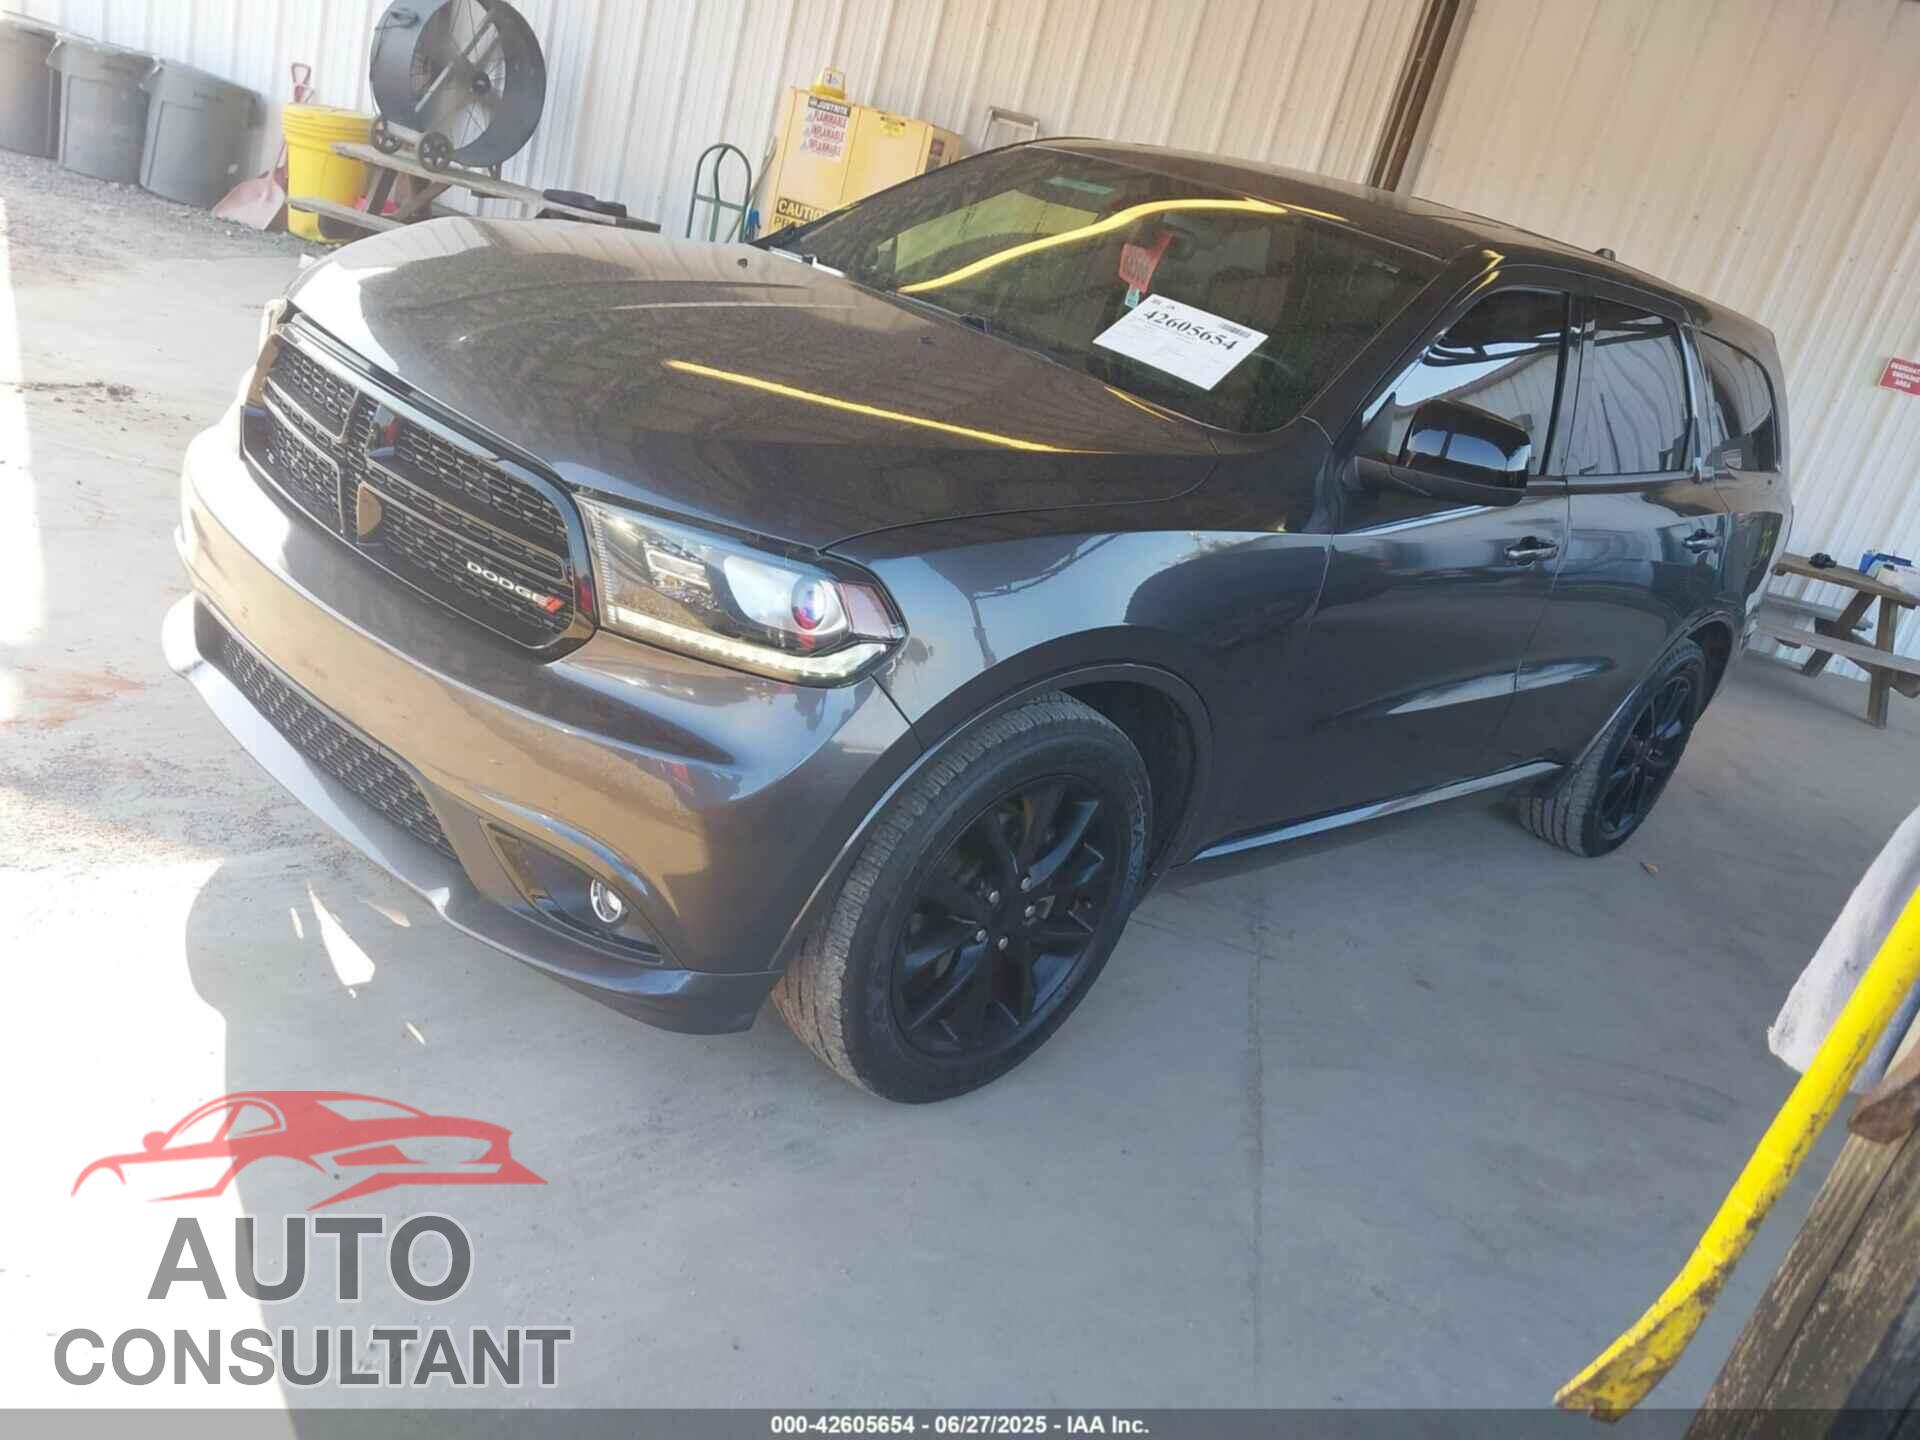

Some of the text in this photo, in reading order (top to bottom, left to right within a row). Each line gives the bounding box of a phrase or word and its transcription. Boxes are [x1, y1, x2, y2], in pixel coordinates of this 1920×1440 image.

[778, 199, 826, 221] CAUTIO
[1144, 310, 1238, 350] 42605654
[466, 560, 549, 607] DODGE
